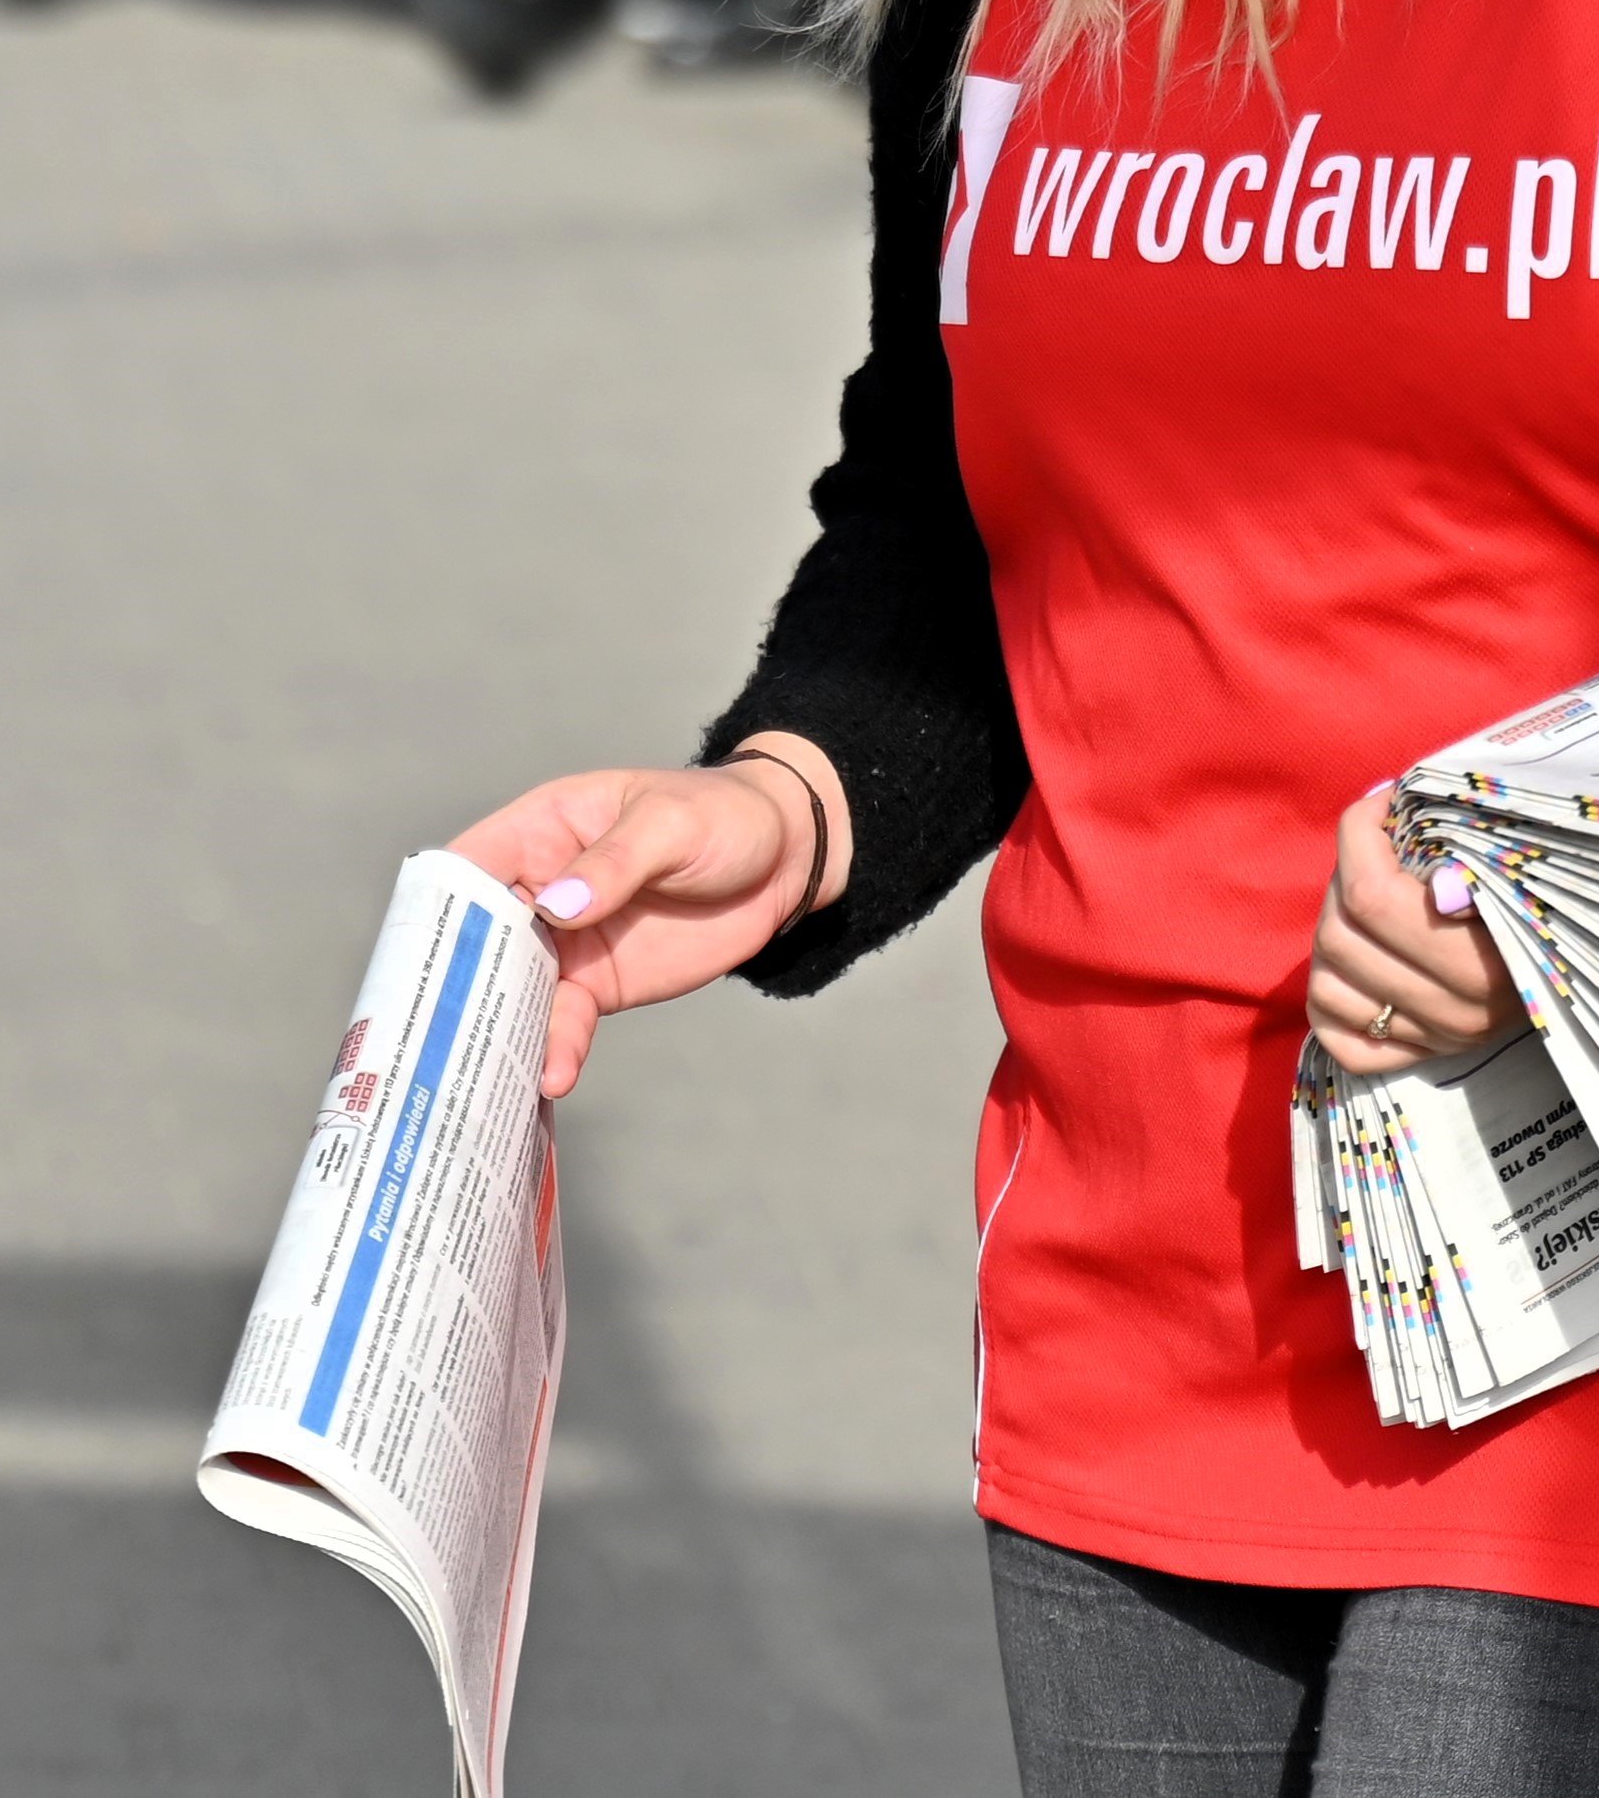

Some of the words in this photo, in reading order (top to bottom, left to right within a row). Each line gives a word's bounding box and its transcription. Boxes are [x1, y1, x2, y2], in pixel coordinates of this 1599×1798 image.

[422, 960, 433, 974] 390
[409, 992, 424, 1020] wynoszą
[485, 1016, 498, 1035] MPK
[393, 1048, 405, 1063] ulicy
[471, 1034, 491, 1085] wrocławskiego
[384, 1077, 394, 1088] 113
[389, 1063, 399, 1079] przy
[458, 1084, 475, 1123] pasażerów
[1545, 1098, 1576, 1125] wym
[367, 1097, 389, 1137] Podstawową
[393, 1083, 430, 1173] odpowiedzi
[1490, 1118, 1546, 1158] Dworze
[1545, 1118, 1587, 1151] sługa
[360, 1138, 376, 1159] Szkołą
[1526, 1145, 1546, 1166] SP
[355, 1370, 369, 1396] zmiany
[366, 1315, 385, 1362] połączeniach
[379, 1271, 399, 1314] komunikacji
[395, 1241, 411, 1272] miejskiej
[403, 1198, 422, 1241] Wrocławia?
[416, 1168, 433, 1199] Zadajesz
[428, 1150, 439, 1168] sobie
[444, 1089, 457, 1112] dalej?
[451, 1076, 463, 1091] Czy
[457, 1041, 474, 1077] dojedziesz
[472, 1012, 484, 1031] pracy
[483, 971, 497, 997] samym
[385, 1170, 402, 1182] i
[1498, 1159, 1524, 1182] 113
[1561, 1175, 1577, 1192] FAT
[346, 1165, 365, 1209] przystankami
[1543, 1188, 1555, 1202] od
[1558, 1177, 1599, 1211] dzieckiem?
[368, 1181, 399, 1242] Pytania
[447, 1192, 463, 1234] pierwszych
[1532, 1196, 1543, 1208] ul.
[333, 1208, 350, 1248] wskazanymi
[1519, 1221, 1530, 1233] do
[1530, 1204, 1558, 1228] Dojazd
[411, 1213, 434, 1262] Odpowiadamy
[324, 1249, 337, 1272] między
[310, 1272, 329, 1306] Odległości
[404, 1260, 417, 1293] zmiany?
[394, 1292, 409, 1318] kolejne
[388, 1318, 402, 1336] będą
